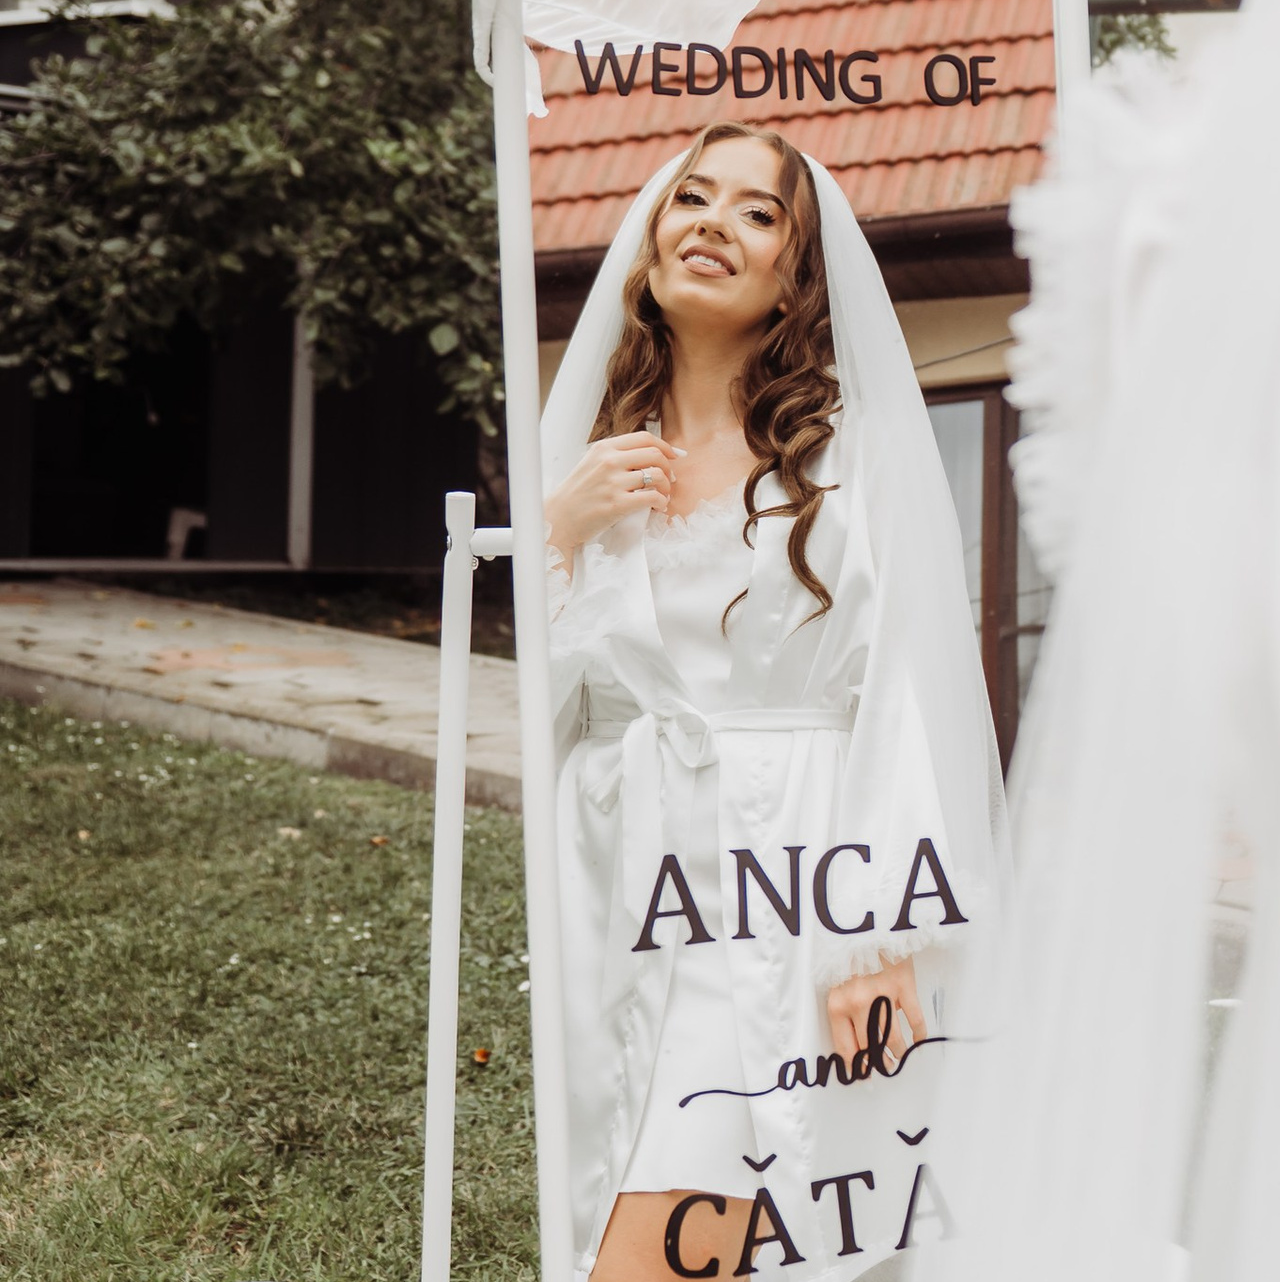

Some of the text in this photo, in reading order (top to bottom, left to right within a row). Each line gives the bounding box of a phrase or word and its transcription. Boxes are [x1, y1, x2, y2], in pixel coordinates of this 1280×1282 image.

[574, 39, 997, 107] WEDDING OF
[631, 837, 970, 952] ANCA
